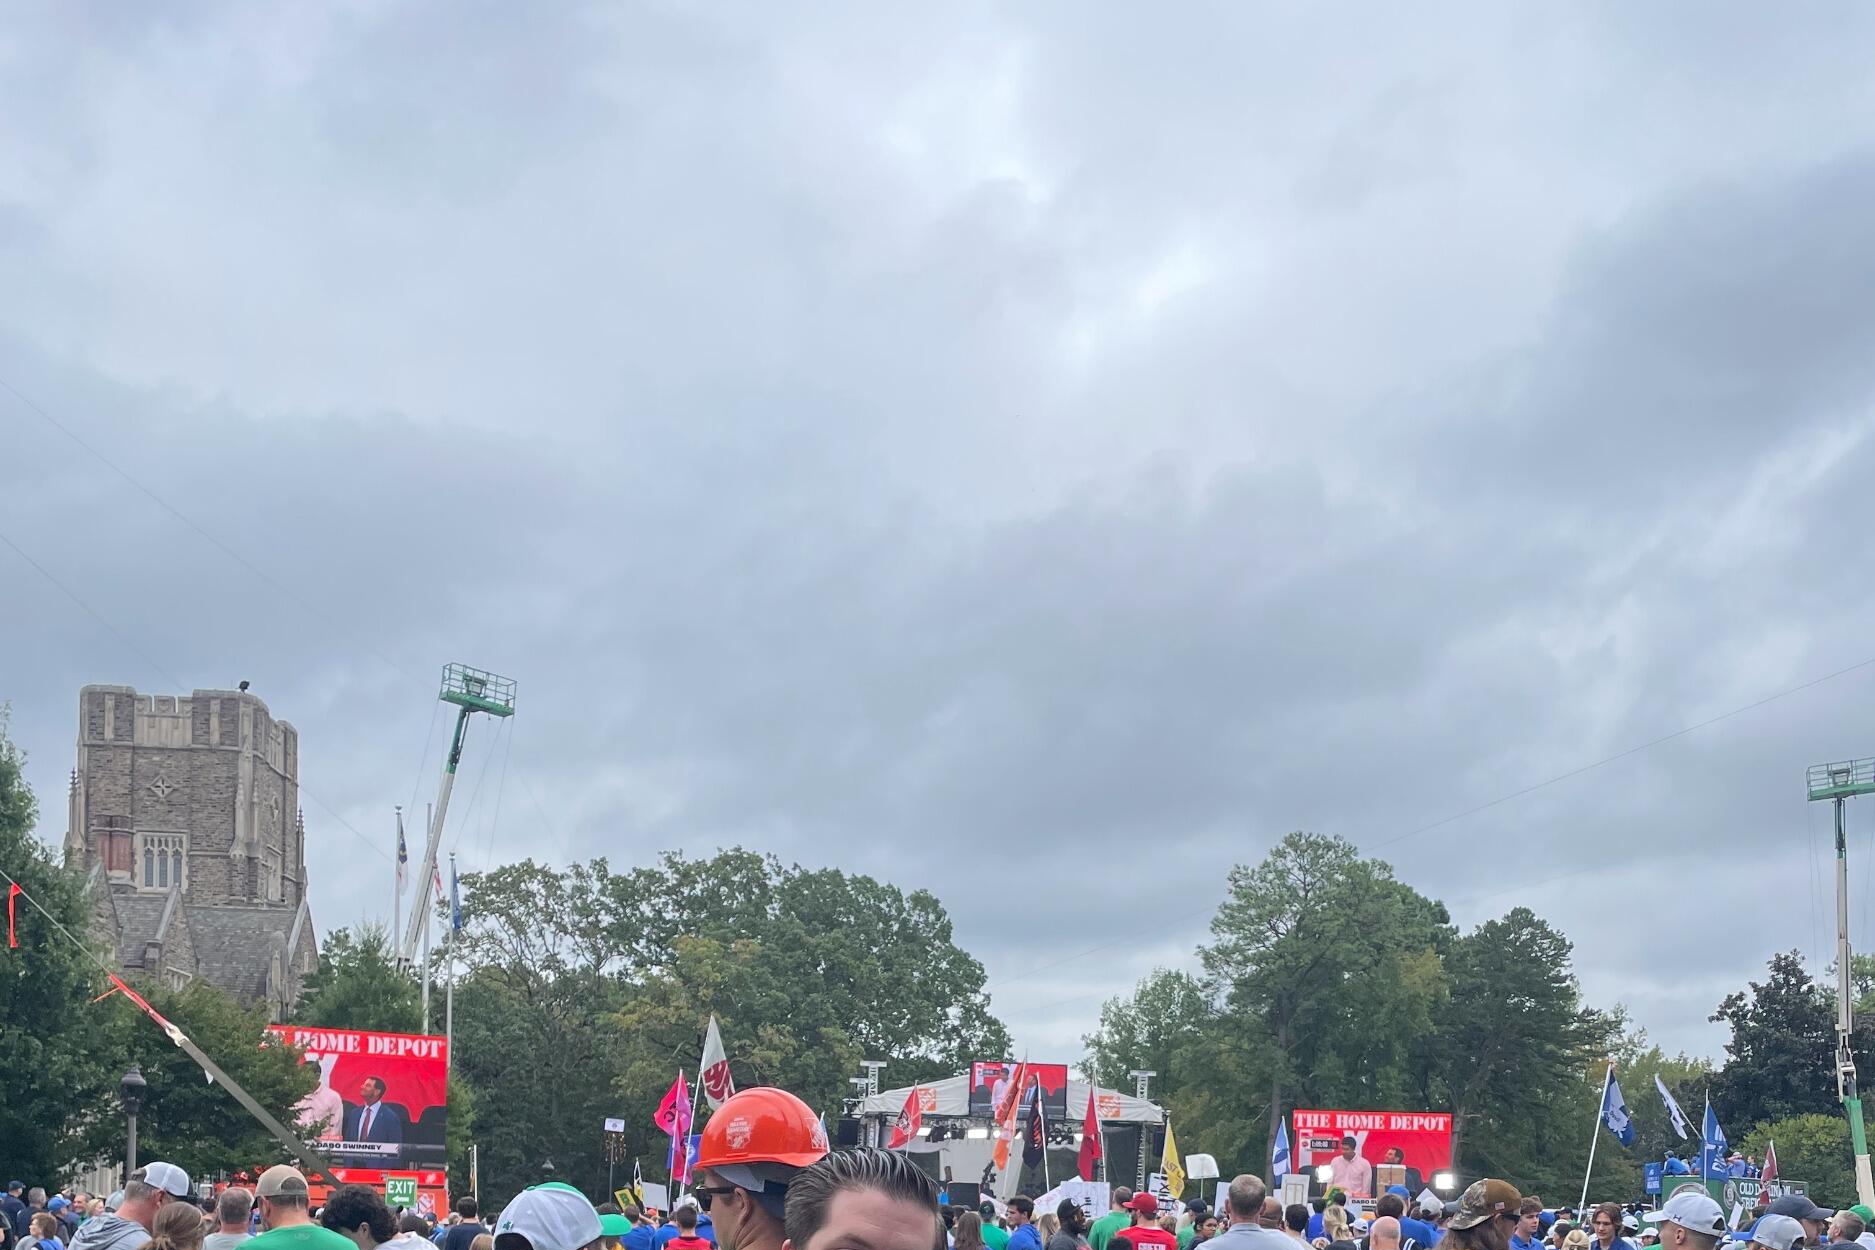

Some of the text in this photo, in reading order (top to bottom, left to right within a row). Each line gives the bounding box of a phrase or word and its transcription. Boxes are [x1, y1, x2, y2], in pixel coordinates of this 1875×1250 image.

[294, 1031, 361, 1053] HOME
[368, 1036, 443, 1058] DEPOT
[1295, 1113, 1447, 1131] THE HOME DEPOT
[343, 1143, 382, 1151] SWINNEY
[387, 1180, 415, 1194] EXIT
[1740, 1182, 1754, 1195] OLD
